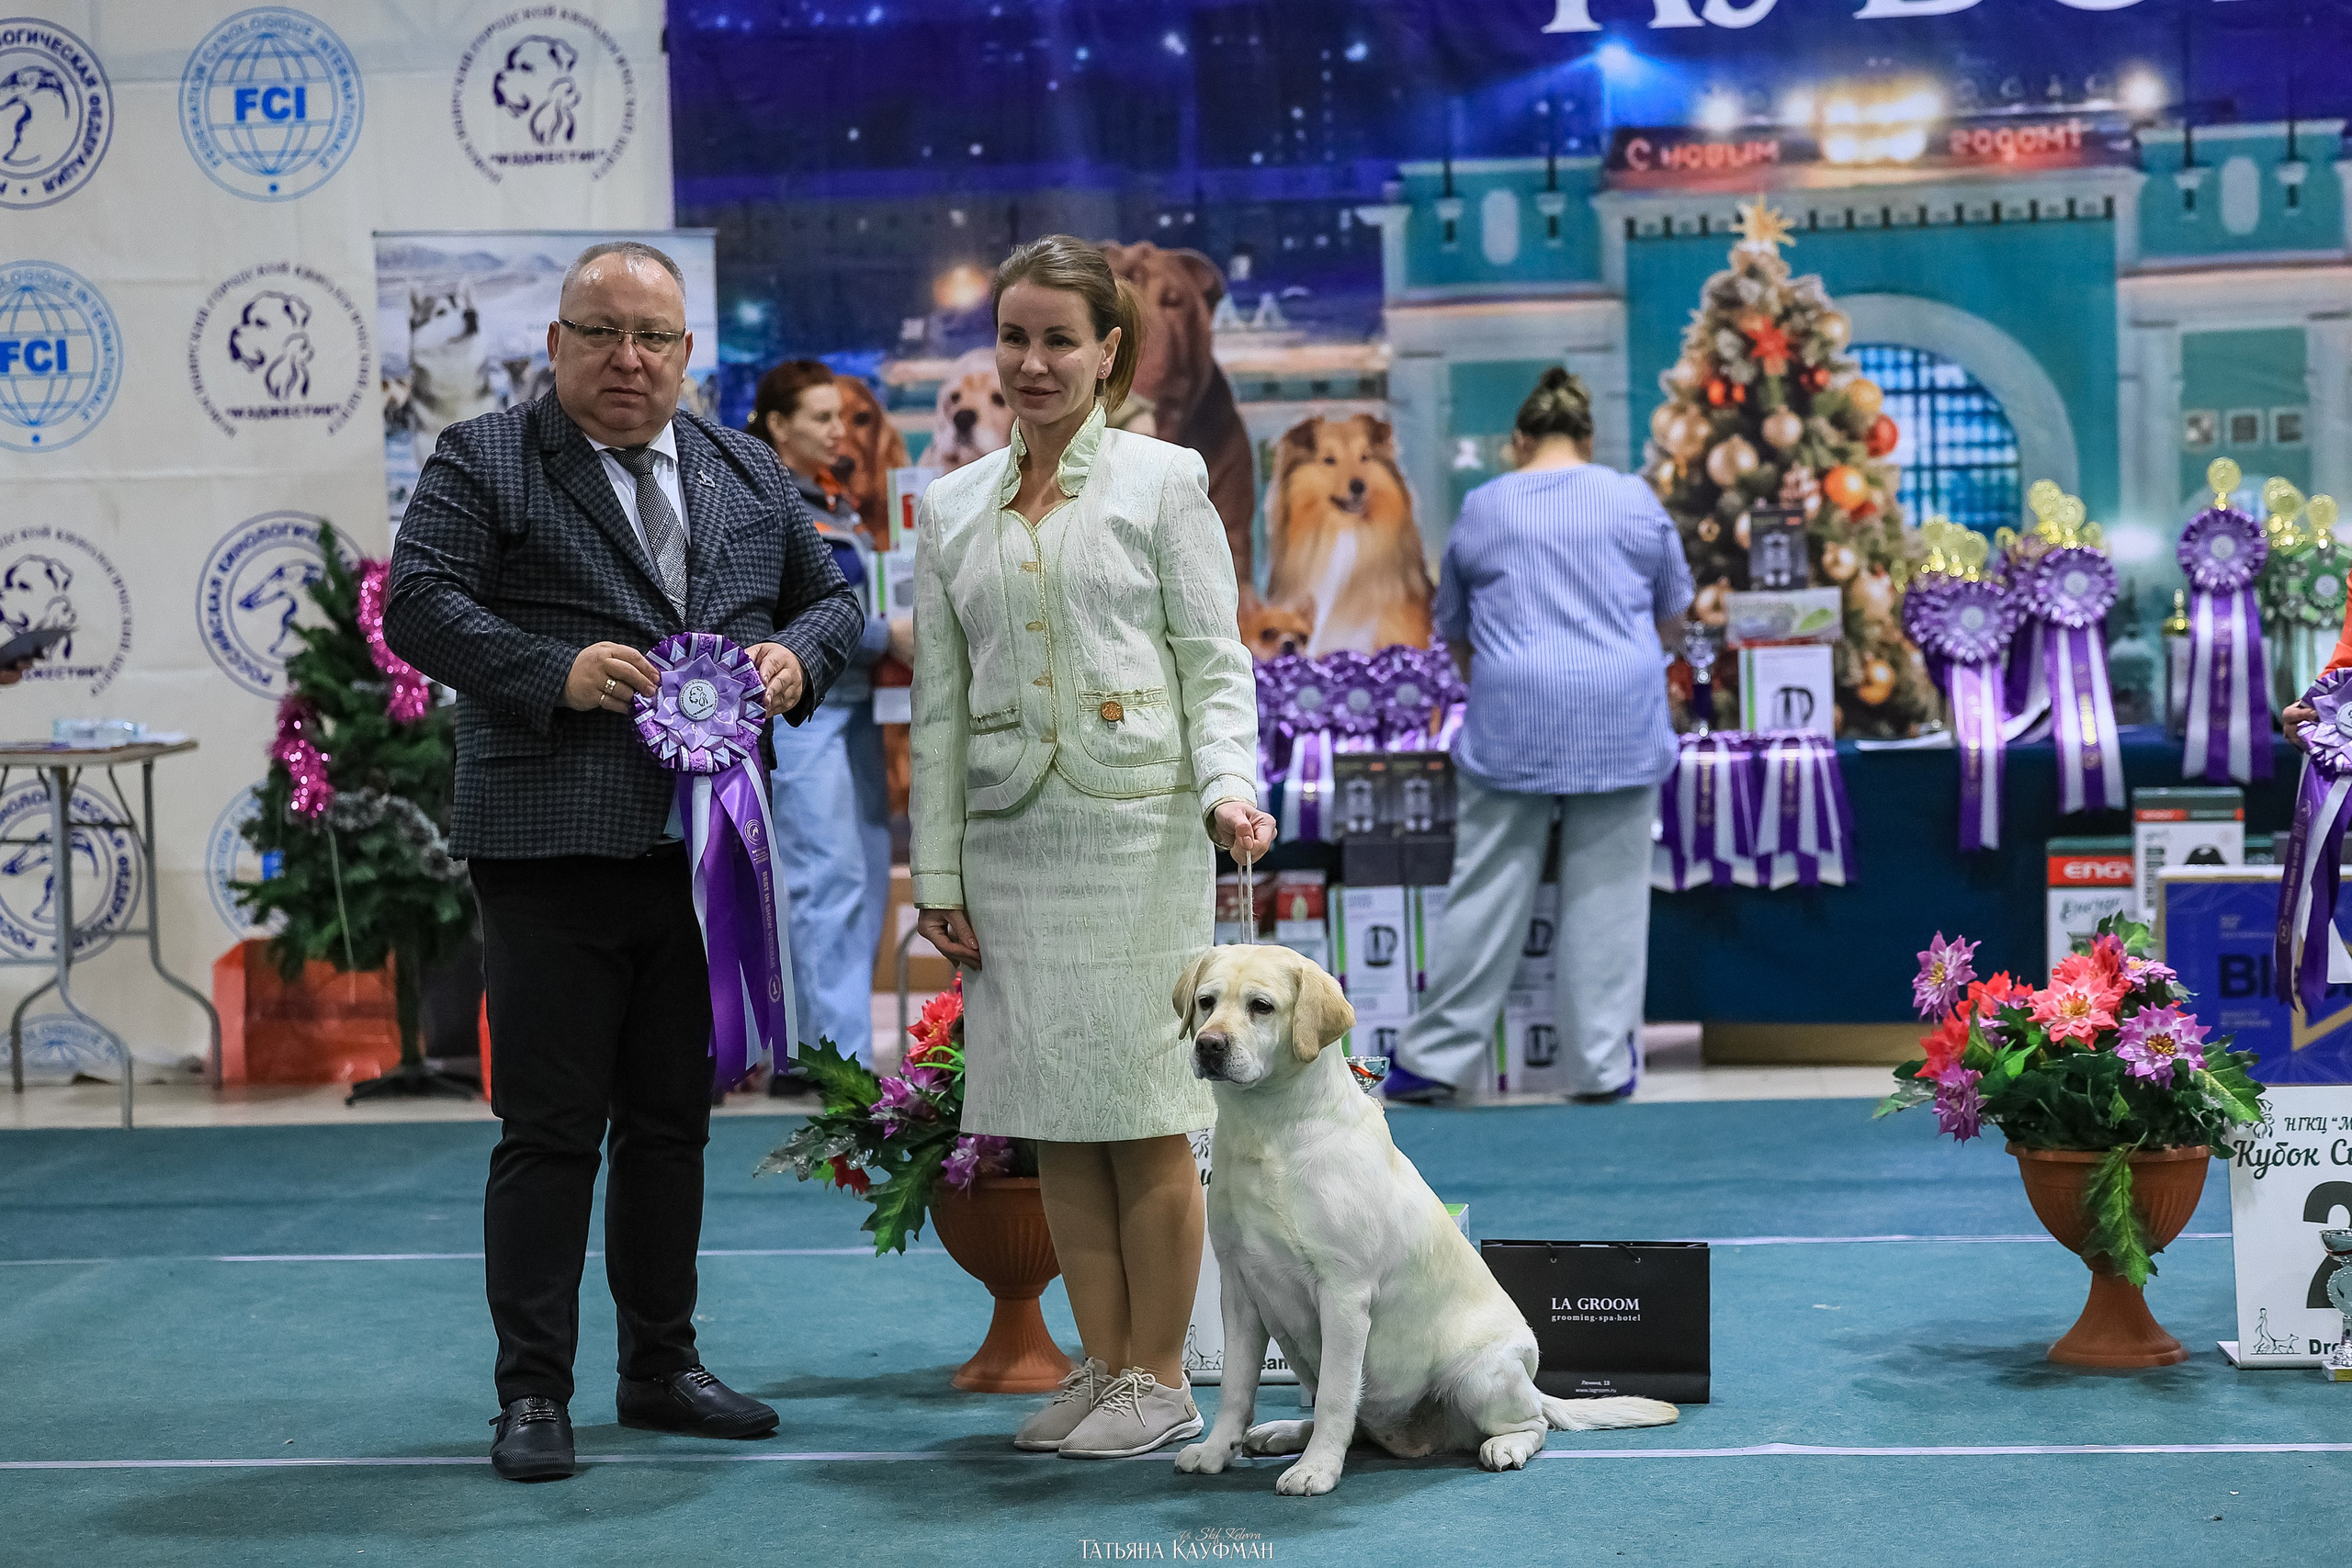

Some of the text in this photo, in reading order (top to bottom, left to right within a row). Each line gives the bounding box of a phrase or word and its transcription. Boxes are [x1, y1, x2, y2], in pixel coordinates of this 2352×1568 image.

[233, 86, 307, 121] FCI
[0, 339, 68, 374] FCI
[2284, 1117, 2327, 1134] НГКЦ
[2234, 1138, 2321, 1180] Кубок
[1551, 1297, 1640, 1311] LA GROOM
